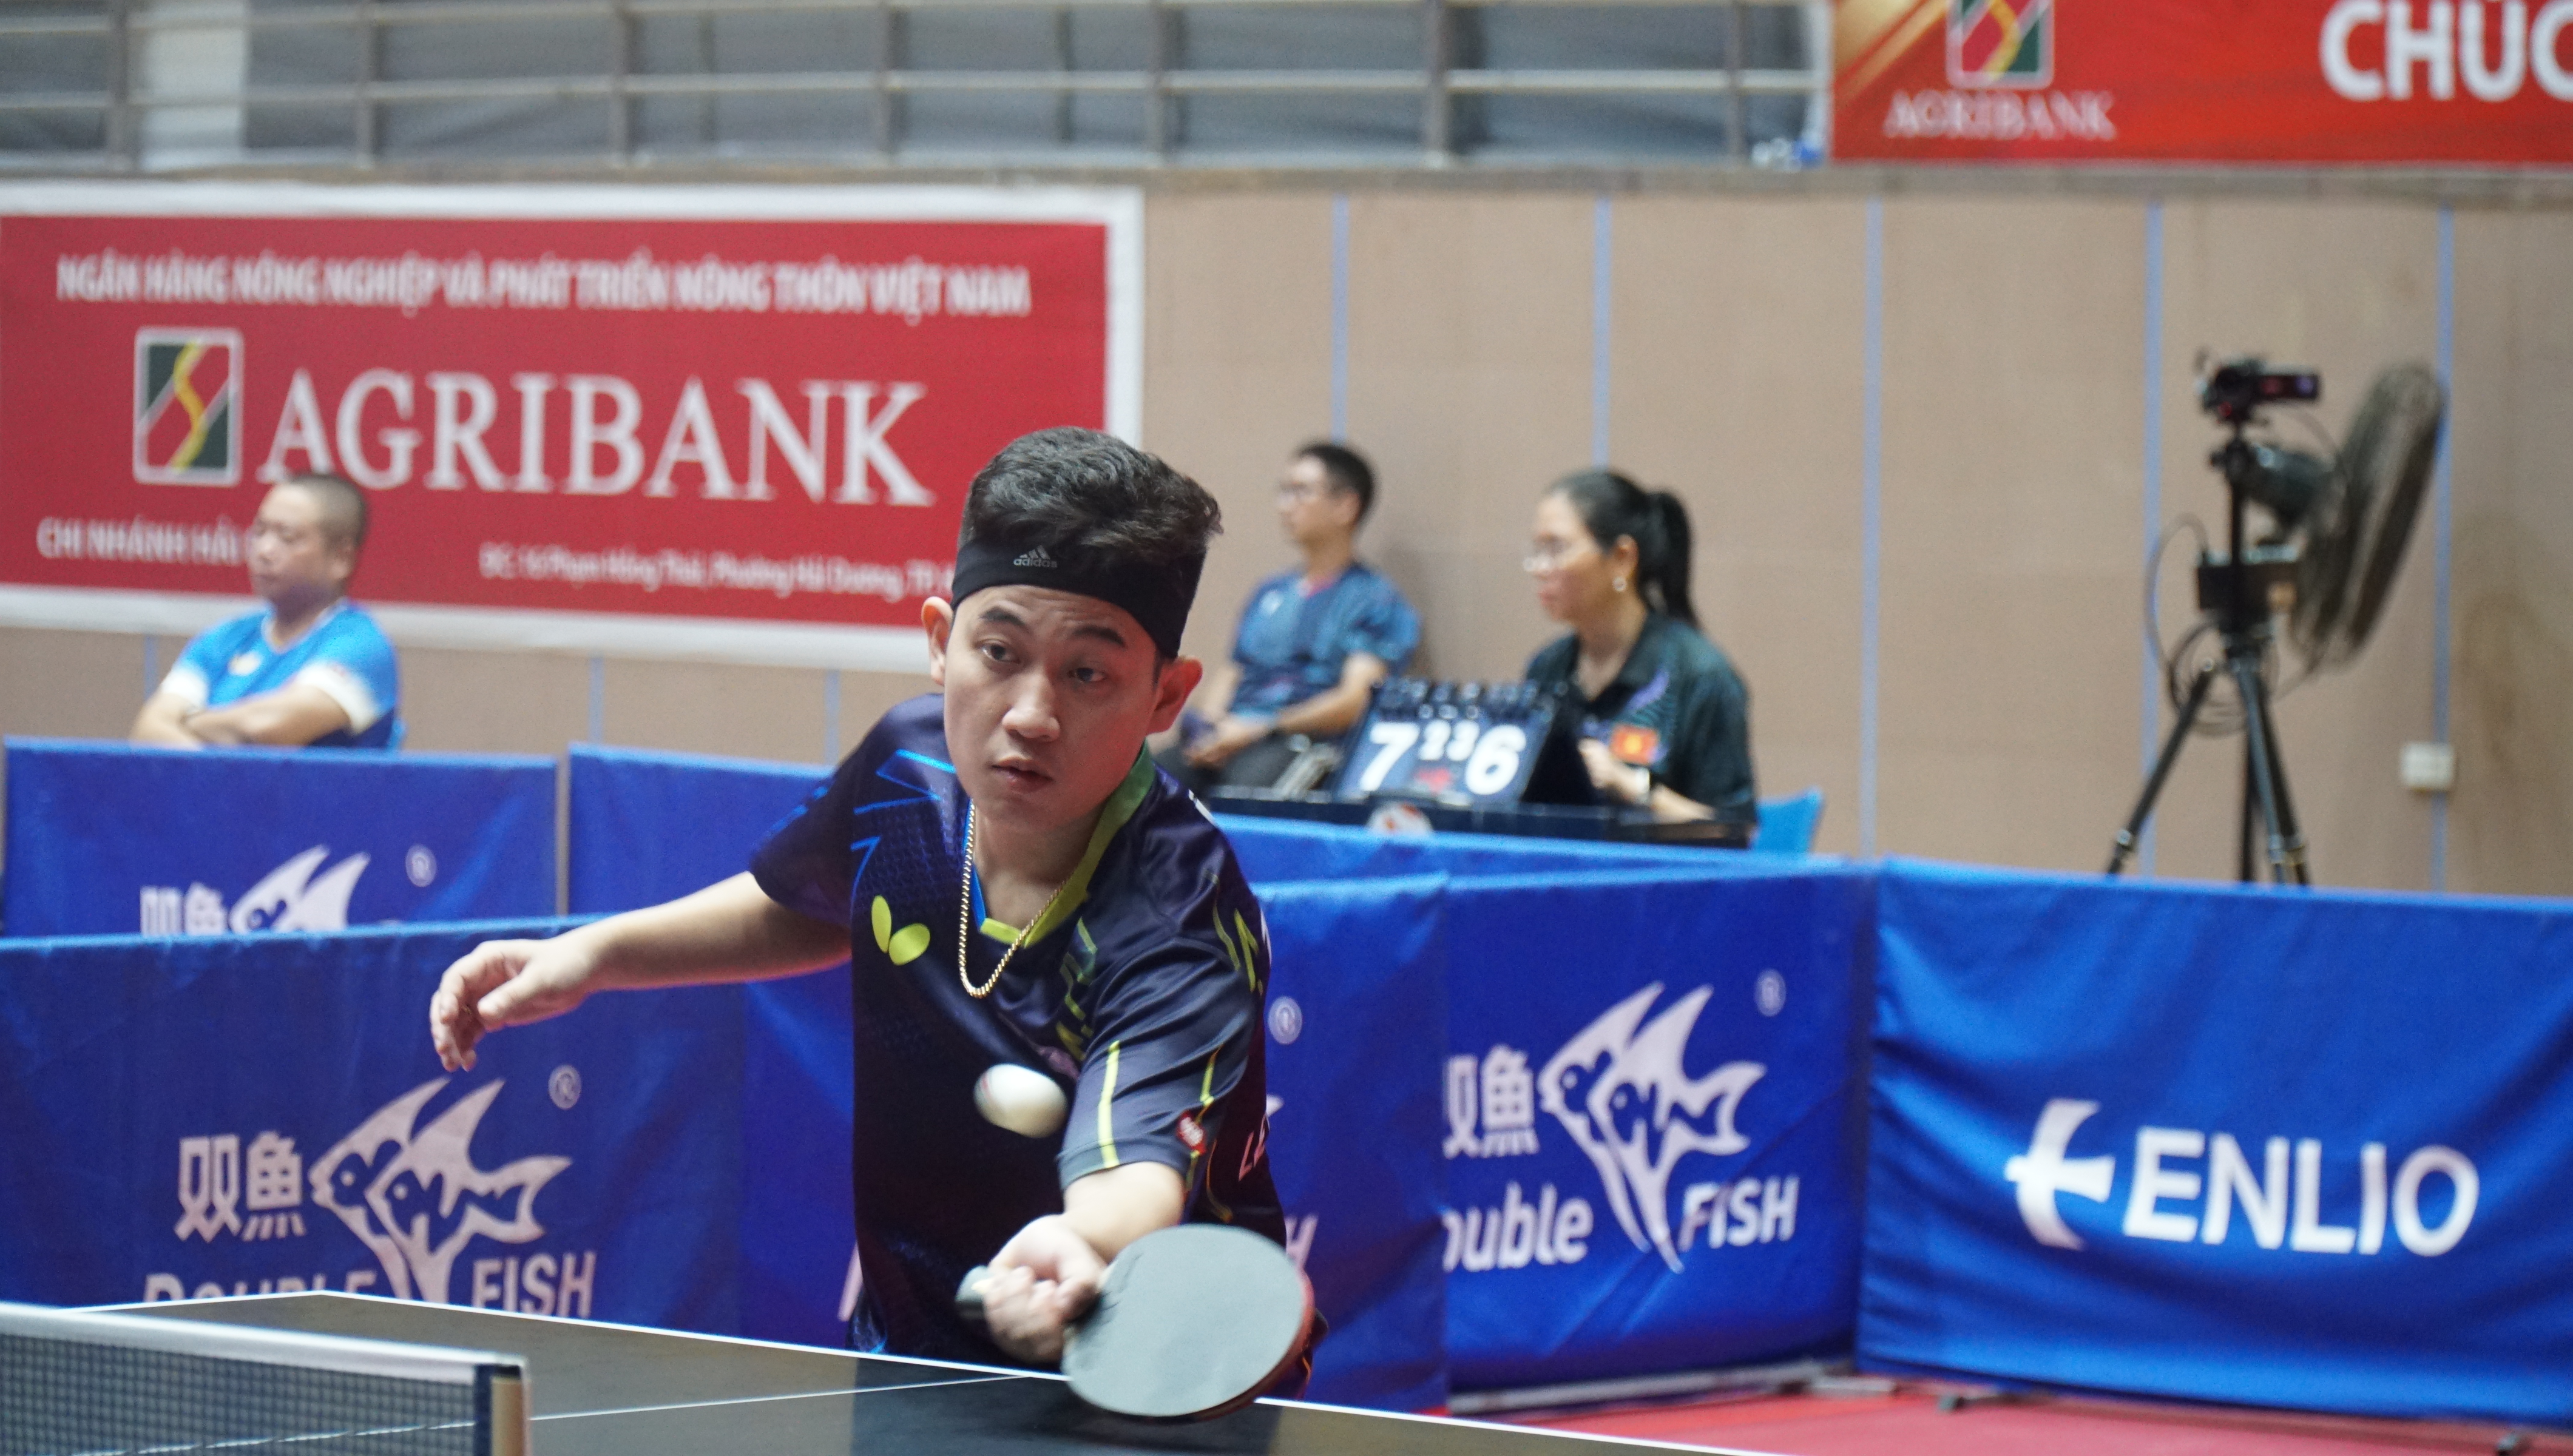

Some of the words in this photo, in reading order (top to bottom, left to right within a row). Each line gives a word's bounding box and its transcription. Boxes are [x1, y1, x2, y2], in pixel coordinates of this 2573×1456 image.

[943, 263, 1031, 317] NAM
[256, 368, 936, 507] AGRIBANK
[1013, 557, 1058, 568] adidas
[1359, 721, 1421, 792] 7
[1464, 724, 1527, 796] 6
[1677, 1176, 1800, 1261] FISH
[2122, 1125, 2481, 1258] ENLIO
[472, 1251, 597, 1319] FISH
